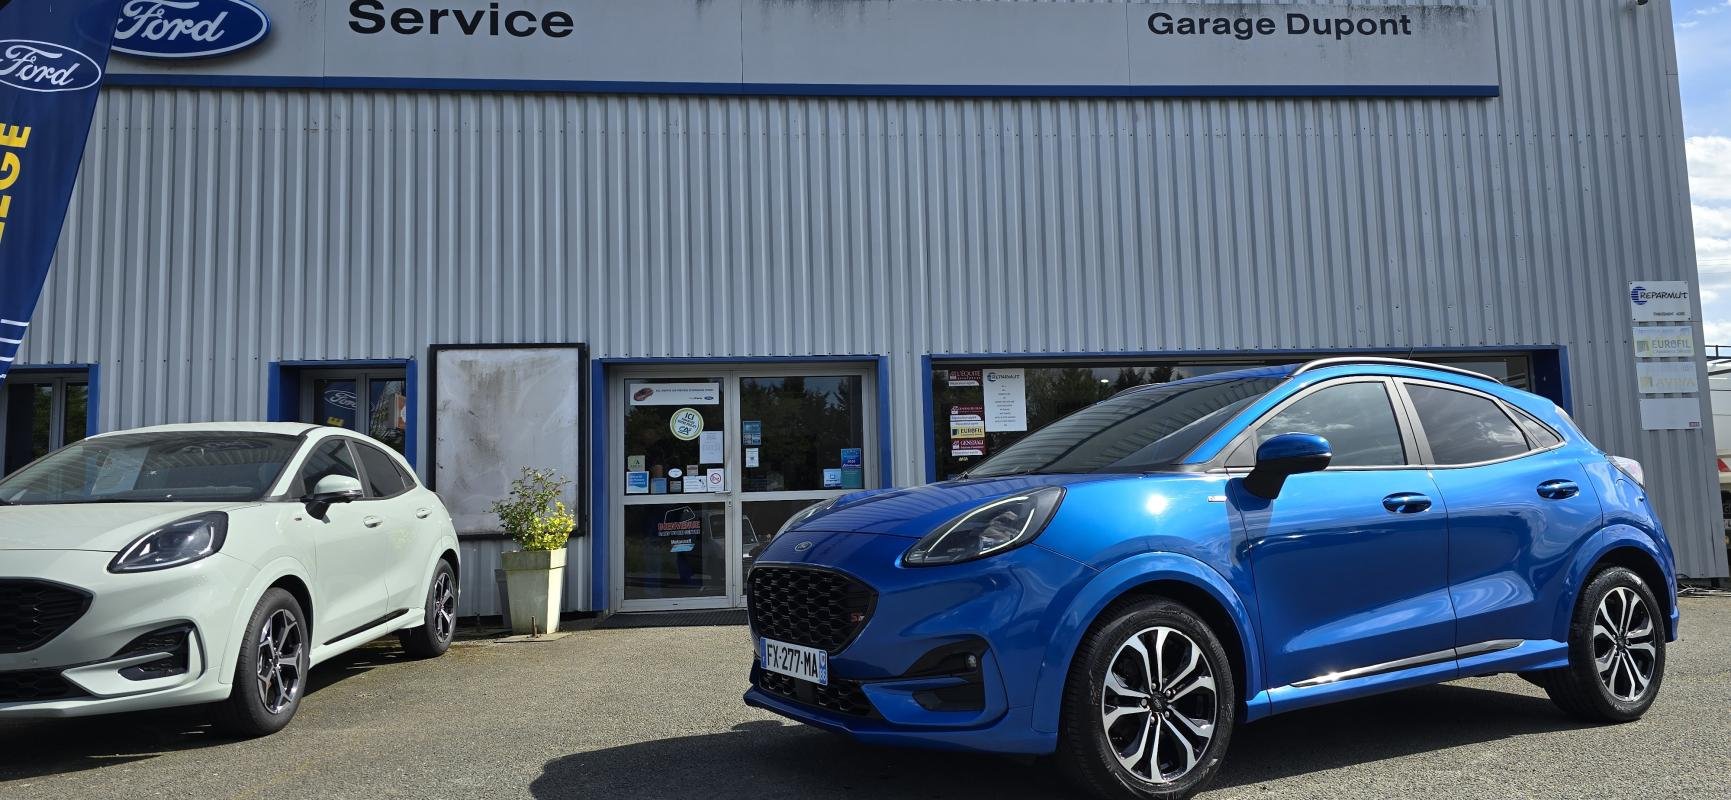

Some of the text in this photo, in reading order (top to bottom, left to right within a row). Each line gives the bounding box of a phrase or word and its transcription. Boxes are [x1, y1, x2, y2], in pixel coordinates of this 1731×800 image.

[114, 0, 228, 42] Ford
[348, 0, 574, 38] Service
[1147, 12, 1412, 40] Garage Dupont
[0, 45, 80, 85] Ford
[1652, 339, 1692, 349] EUROFIL
[767, 643, 818, 678] FX-277-MA
